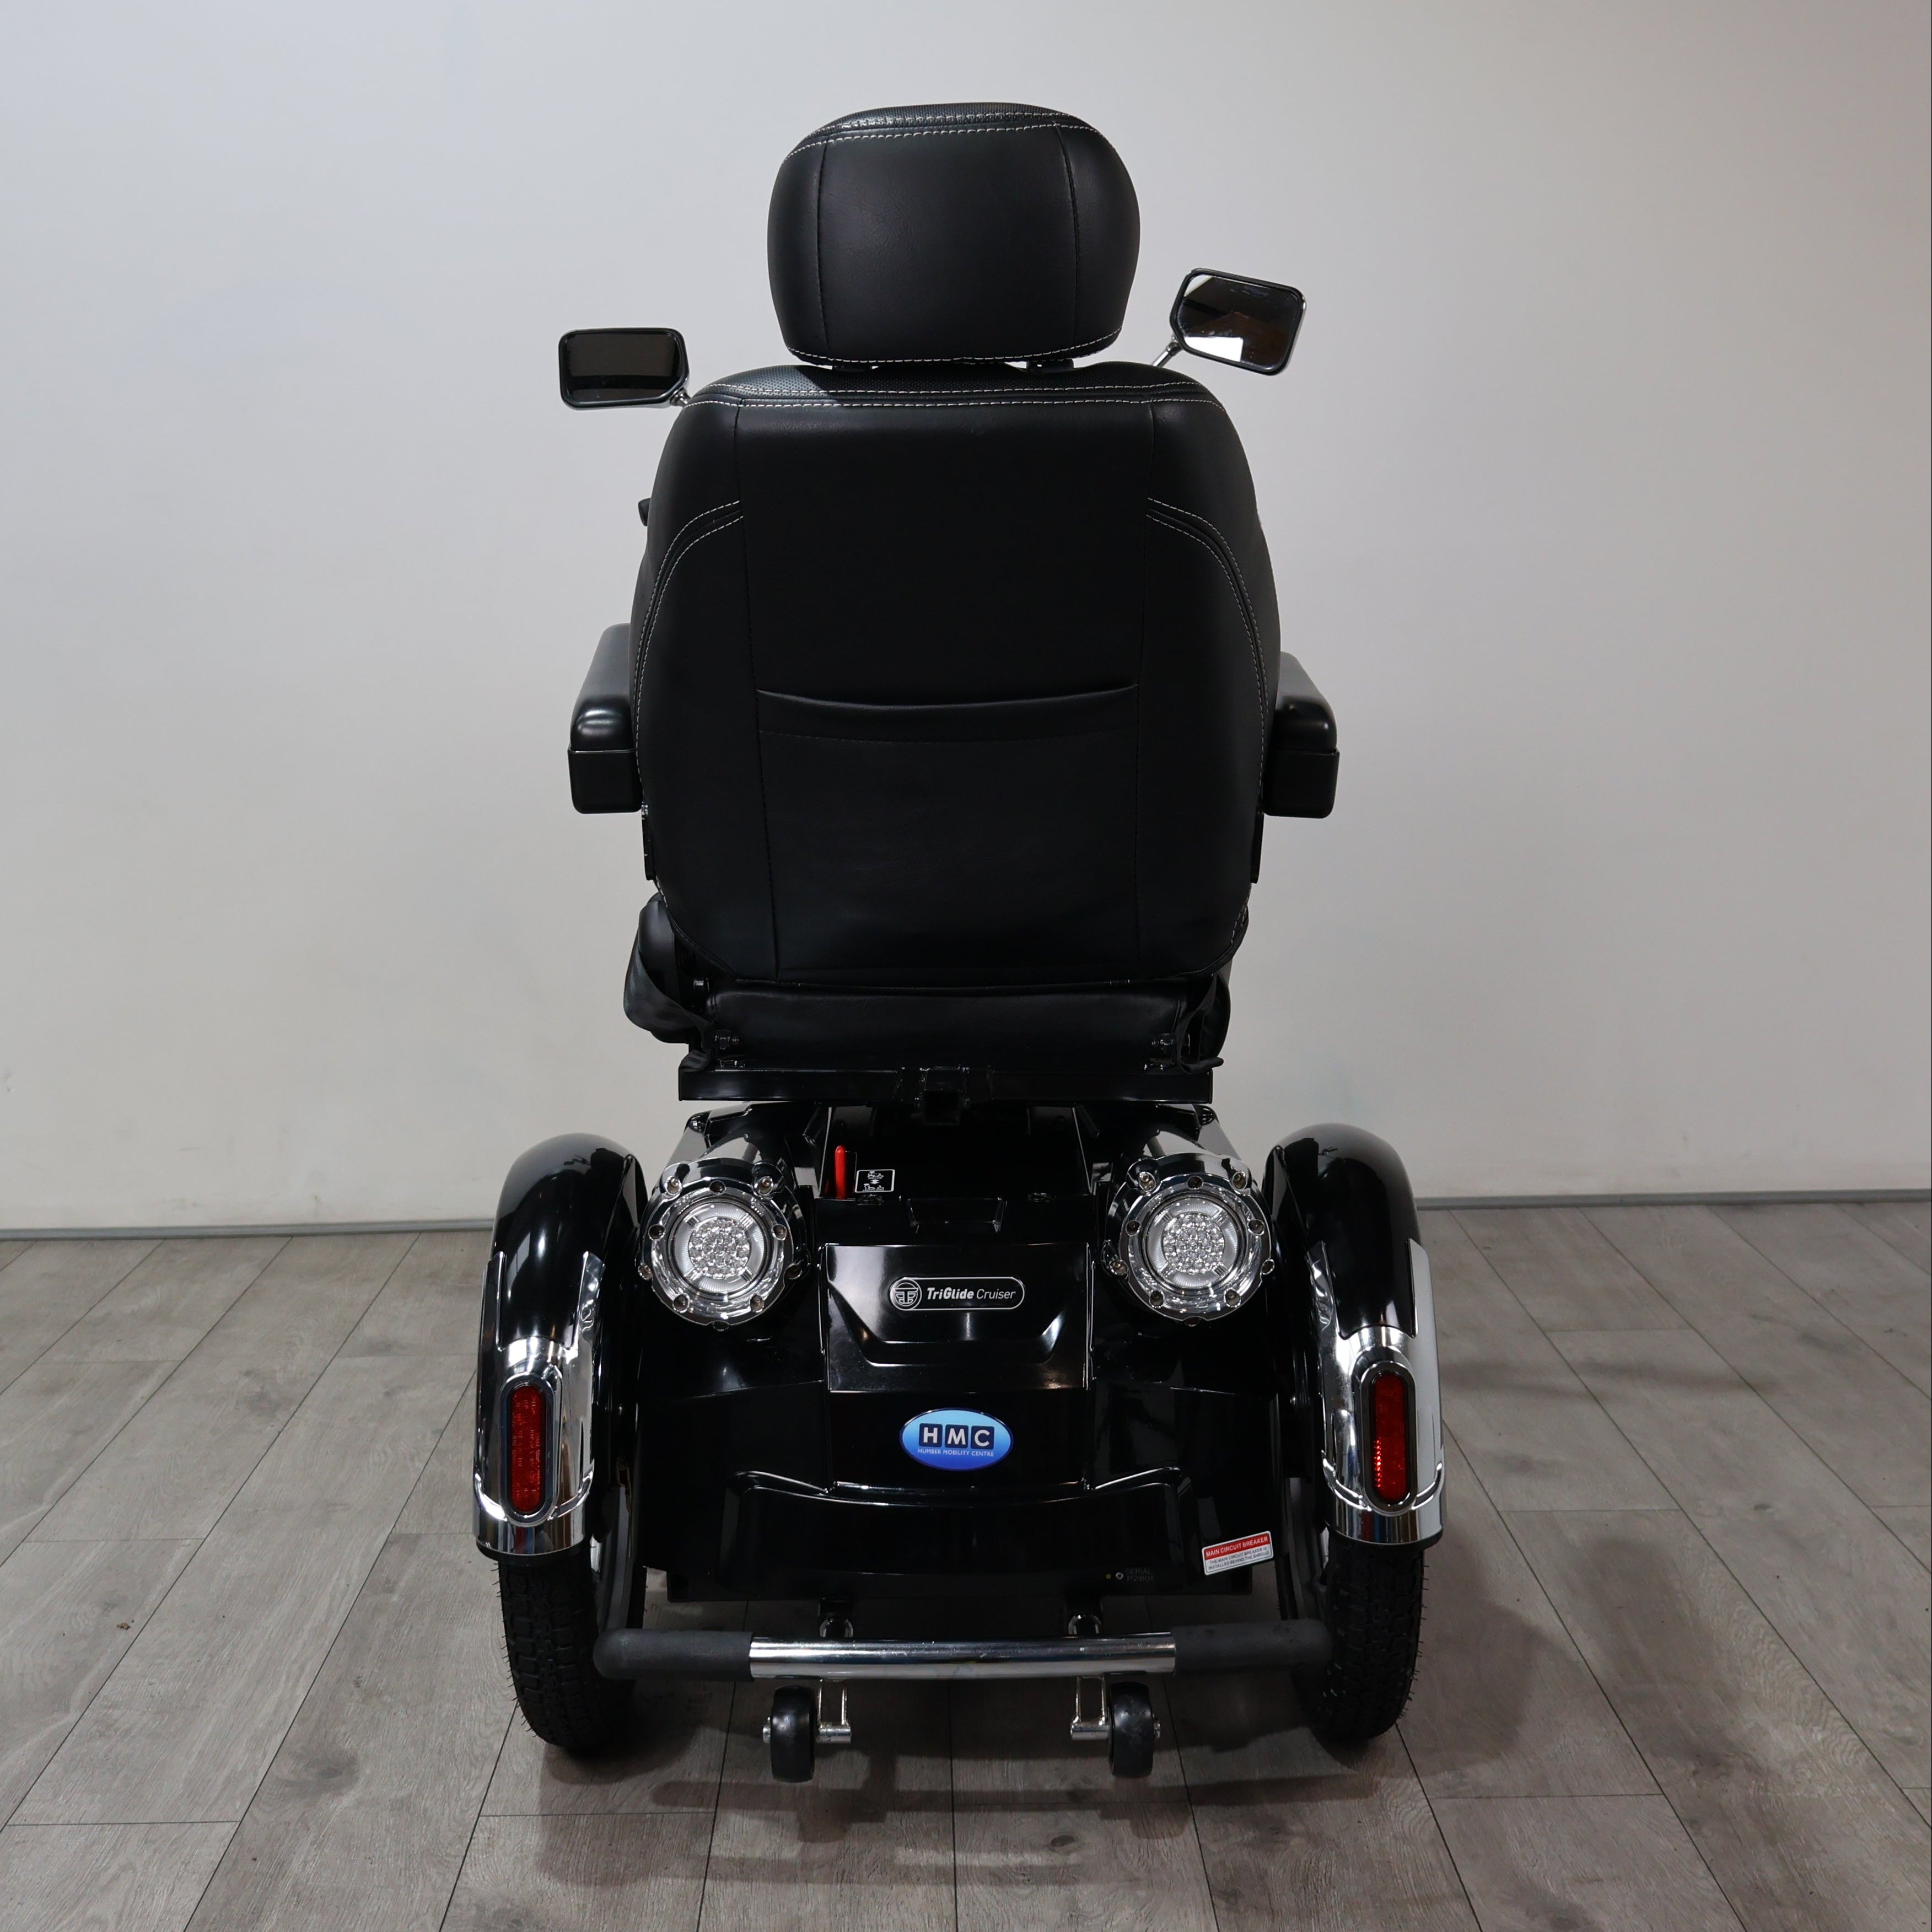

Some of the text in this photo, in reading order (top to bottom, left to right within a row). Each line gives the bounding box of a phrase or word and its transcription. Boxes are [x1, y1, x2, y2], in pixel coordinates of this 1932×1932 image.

[927, 1287, 1016, 1300] TriGlide Cruiser
[923, 1427, 990, 1447] HMC
[1220, 1543, 1241, 1553] CIRCUIT
[1242, 1536, 1268, 1547] BREAKER
[1208, 1561, 1229, 1570] INSTALLED
